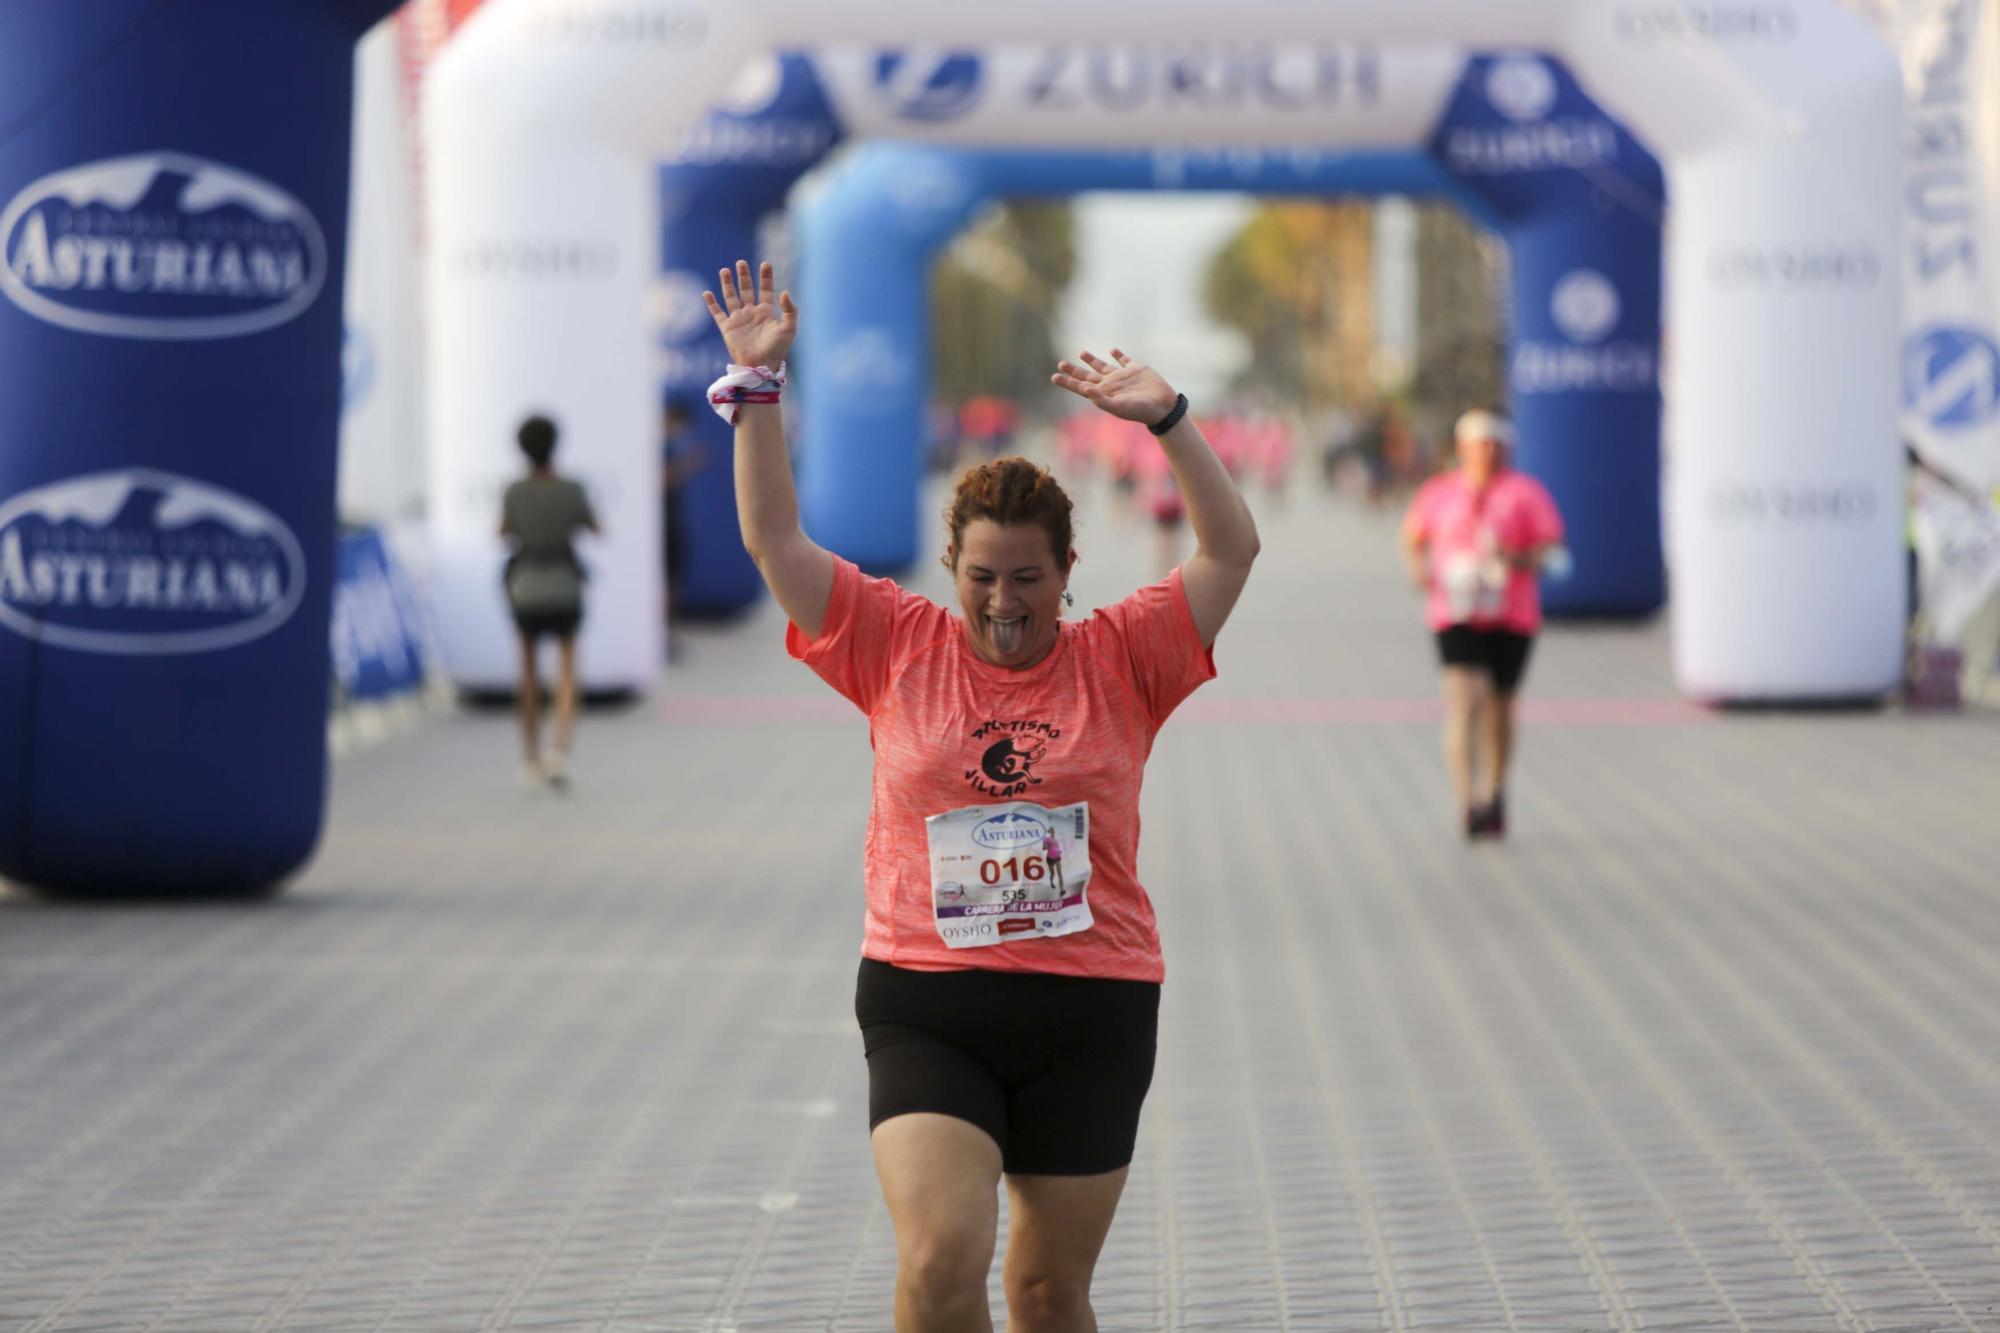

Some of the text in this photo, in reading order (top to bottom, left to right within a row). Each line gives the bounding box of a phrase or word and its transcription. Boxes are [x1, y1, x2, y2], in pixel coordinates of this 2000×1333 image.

[964, 769, 1028, 798] VILLAR
[978, 827, 1041, 842] ASTURIANA
[980, 855, 1045, 884] 016
[964, 904, 1005, 916] CARRERA
[1020, 902, 1033, 912] LA
[942, 923, 992, 939] OYSHO
